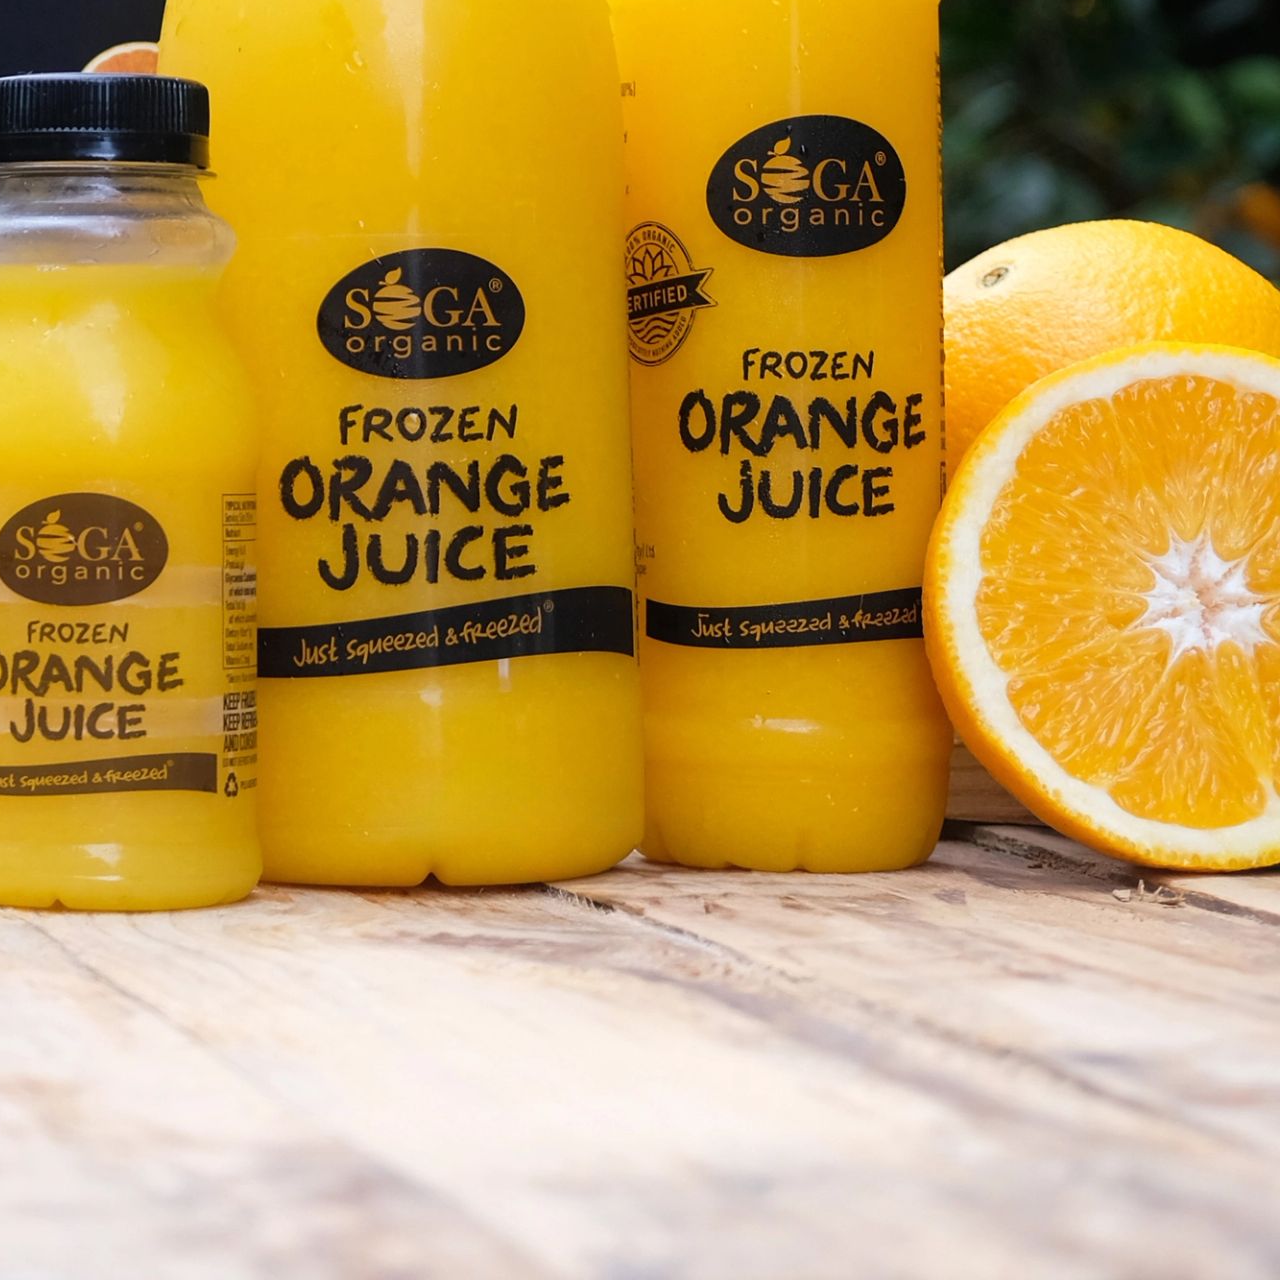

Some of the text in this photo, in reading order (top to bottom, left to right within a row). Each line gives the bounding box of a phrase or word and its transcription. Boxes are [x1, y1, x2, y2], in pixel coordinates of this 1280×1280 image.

[733, 203, 886, 233] organic
[627, 284, 688, 313] ERTIFIED
[345, 326, 502, 359] organic
[742, 347, 875, 382] FROZEN
[338, 403, 519, 445] FROZEN
[678, 388, 926, 459] ORANGE
[279, 453, 571, 522] ORANGE
[717, 458, 895, 524] JUICE
[15, 561, 145, 585] organic
[317, 522, 538, 591] JUICE
[27, 620, 130, 644] FROZEN
[293, 638, 340, 669] Just
[345, 627, 439, 665] squeezed
[444, 627, 458, 646] &
[690, 611, 733, 639] Just
[739, 609, 833, 649] squeezed
[9, 698, 148, 743] JUICE
[19, 771, 88, 791] squeezed
